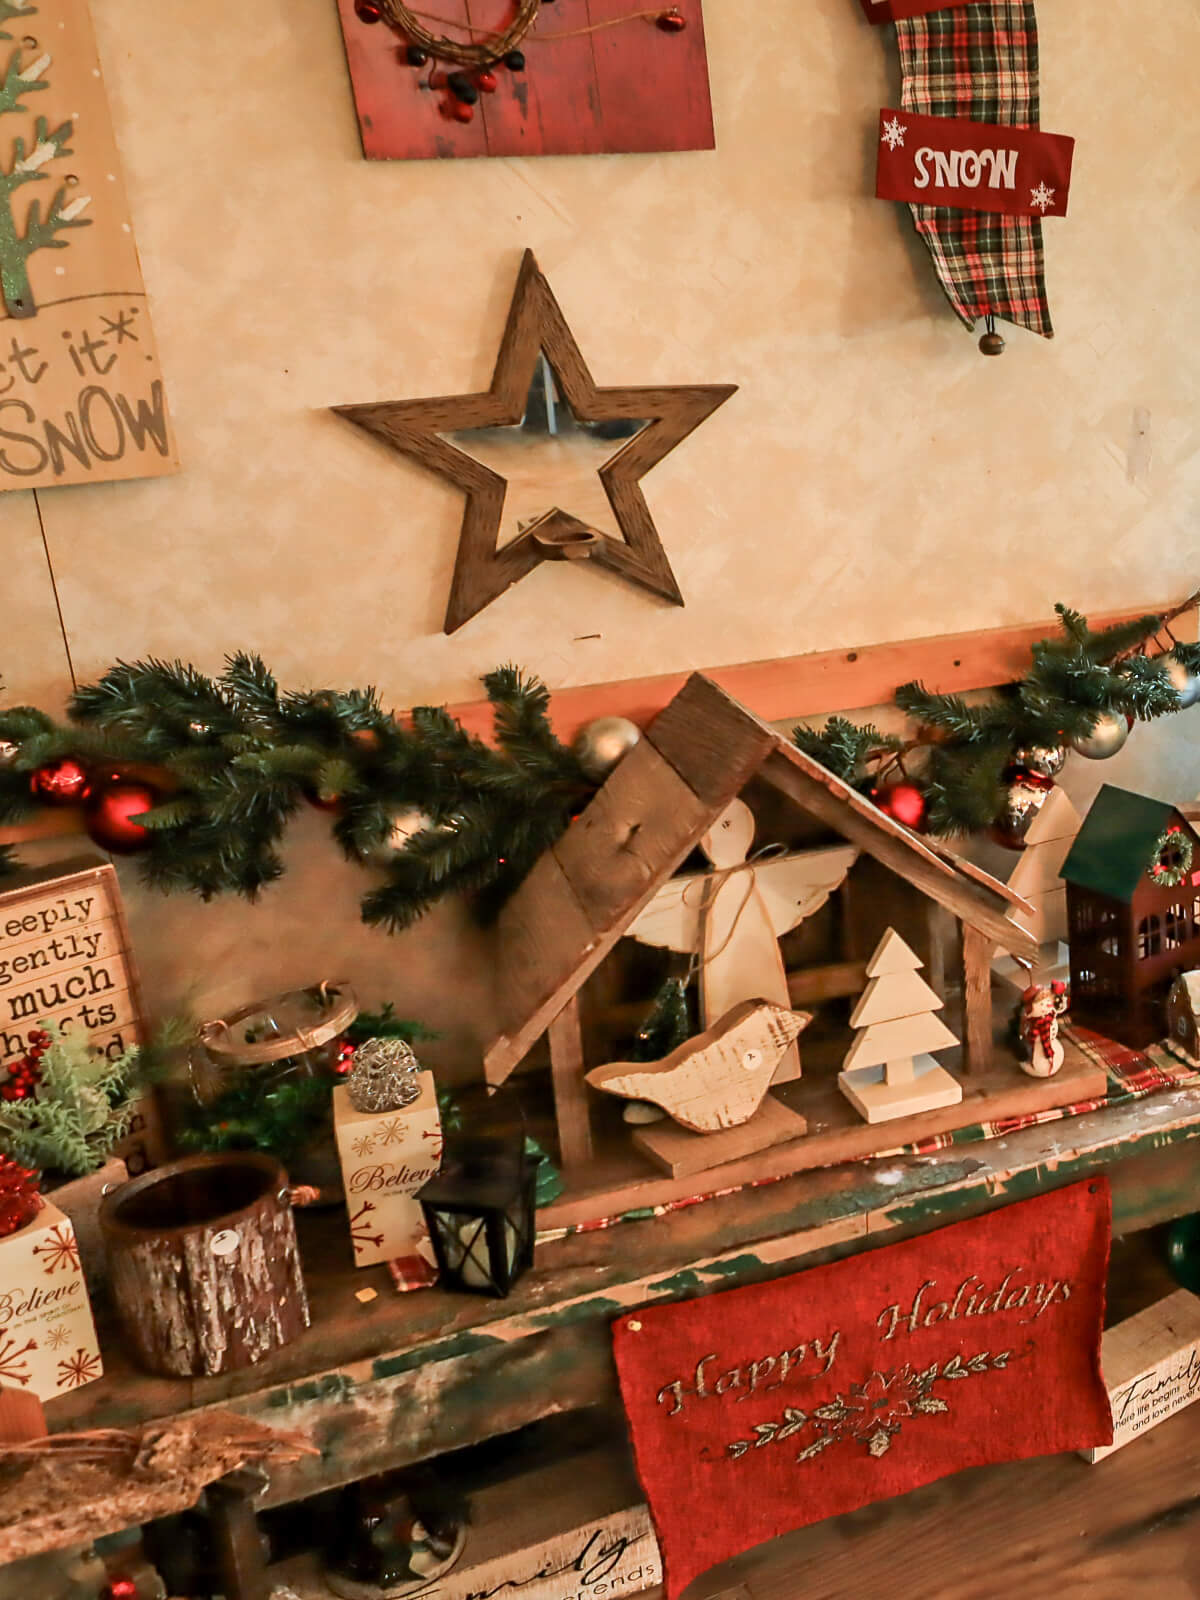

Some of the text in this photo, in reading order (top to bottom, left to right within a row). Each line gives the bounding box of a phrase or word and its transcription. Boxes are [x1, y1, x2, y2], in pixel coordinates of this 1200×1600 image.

[914, 147, 1019, 189] SNOW
[61, 329, 118, 377] it
[0, 379, 169, 476] SNOW
[0, 897, 94, 939] eeply
[0, 931, 103, 985] gently
[8, 965, 115, 1021] much
[877, 1267, 1071, 1342] Holidays
[656, 1331, 842, 1416] Happy
[1113, 1386, 1180, 1430] here life begins
[1132, 1415, 1151, 1431] and
[1152, 1403, 1171, 1419] love
[1172, 1389, 1195, 1406] never
[593, 1564, 655, 1595] ends
